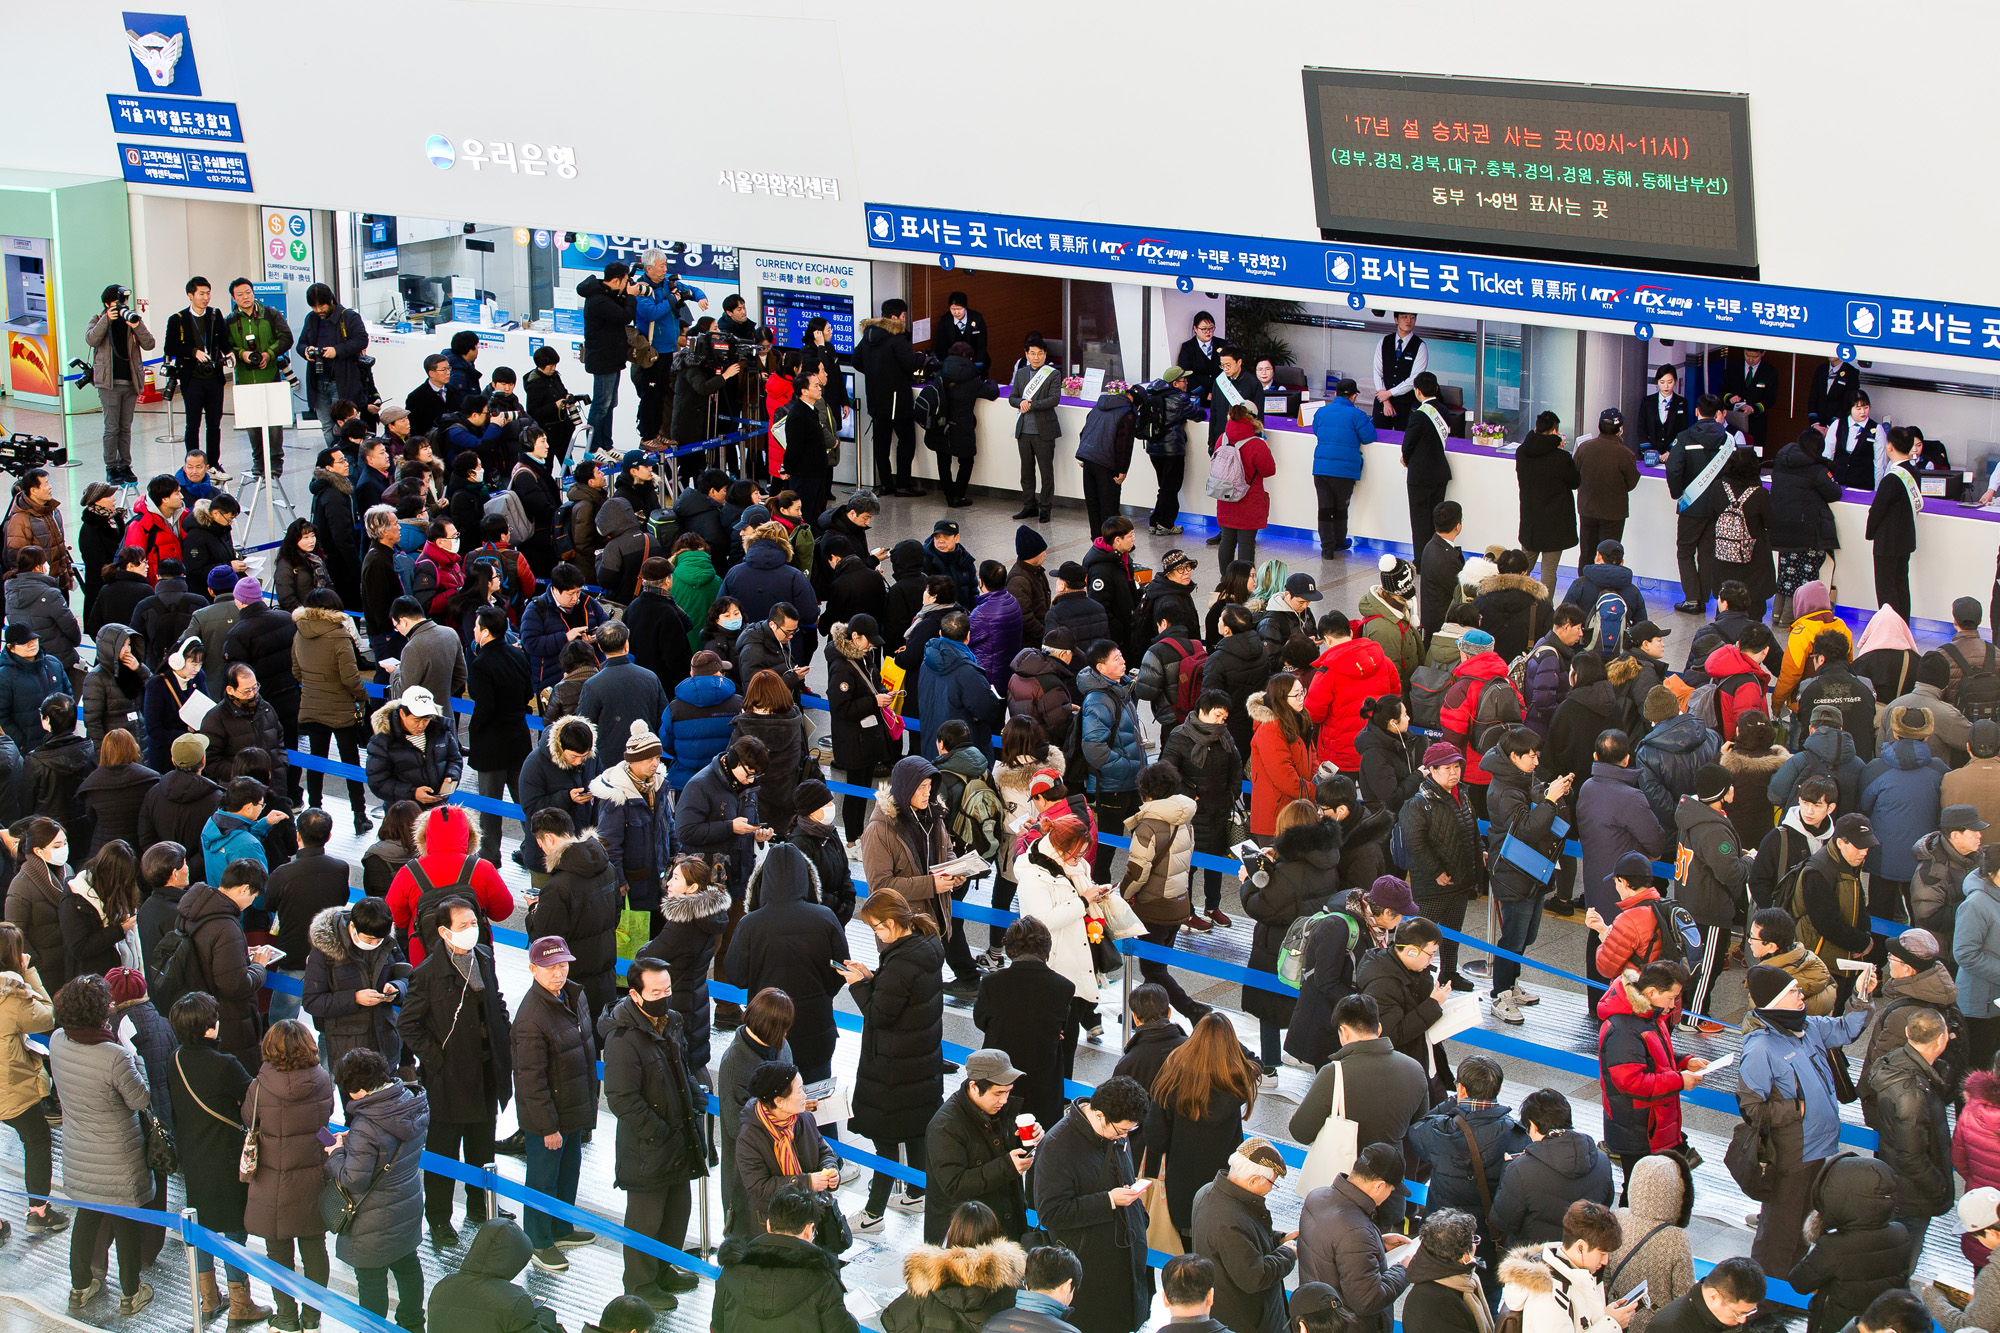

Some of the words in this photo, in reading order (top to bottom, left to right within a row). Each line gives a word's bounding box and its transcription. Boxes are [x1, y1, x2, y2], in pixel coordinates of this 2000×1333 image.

[120, 107, 231, 129] 서울지방철도경찰대
[1402, 119, 1420, 140] 설
[1432, 120, 1490, 144] 승차권
[1504, 126, 1542, 147] 사는
[203, 155, 244, 170] 유실물센터
[461, 138, 579, 180] 우리은행
[718, 170, 841, 201] 서울역환전센터
[1432, 186, 1465, 206] 동부
[1476, 191, 1518, 211] 1~9번
[1529, 194, 1581, 217] 표사는
[1592, 200, 1609, 219] 곳
[901, 216, 961, 246] 표사는
[968, 221, 987, 248] 곳
[994, 227, 1043, 250] Ticket
[1049, 233, 1088, 255] 買票所
[1165, 249, 1189, 260] 새마을
[1198, 248, 1230, 264] 누리로
[755, 258, 803, 271] CURRENCY
[805, 262, 854, 276] EXCHANGE
[943, 257, 949, 267] 1
[1245, 267, 1276, 277] Mugunghwa
[1181, 280, 1188, 290] 2
[1361, 257, 1430, 290] 표사는
[1438, 264, 1459, 293] 곳
[1467, 271, 1524, 296] Ticket
[1531, 278, 1577, 302] 買票所
[1667, 297, 1693, 309] 새마을
[1704, 296, 1741, 315] 누리로
[1352, 297, 1360, 307] 3
[1657, 308, 1683, 316] Saemaeul
[833, 314, 852, 322] 892.07
[1715, 314, 1733, 322] Nuriro
[1759, 319, 1796, 328] Mugunghwa
[1890, 308, 1972, 346] 표사는
[1639, 327, 1648, 337] 4
[482, 333, 505, 342] EXCHANGE
[834, 334, 852, 342] 152.05
[834, 344, 852, 352] 166.21
[1842, 348, 1851, 359] 5
